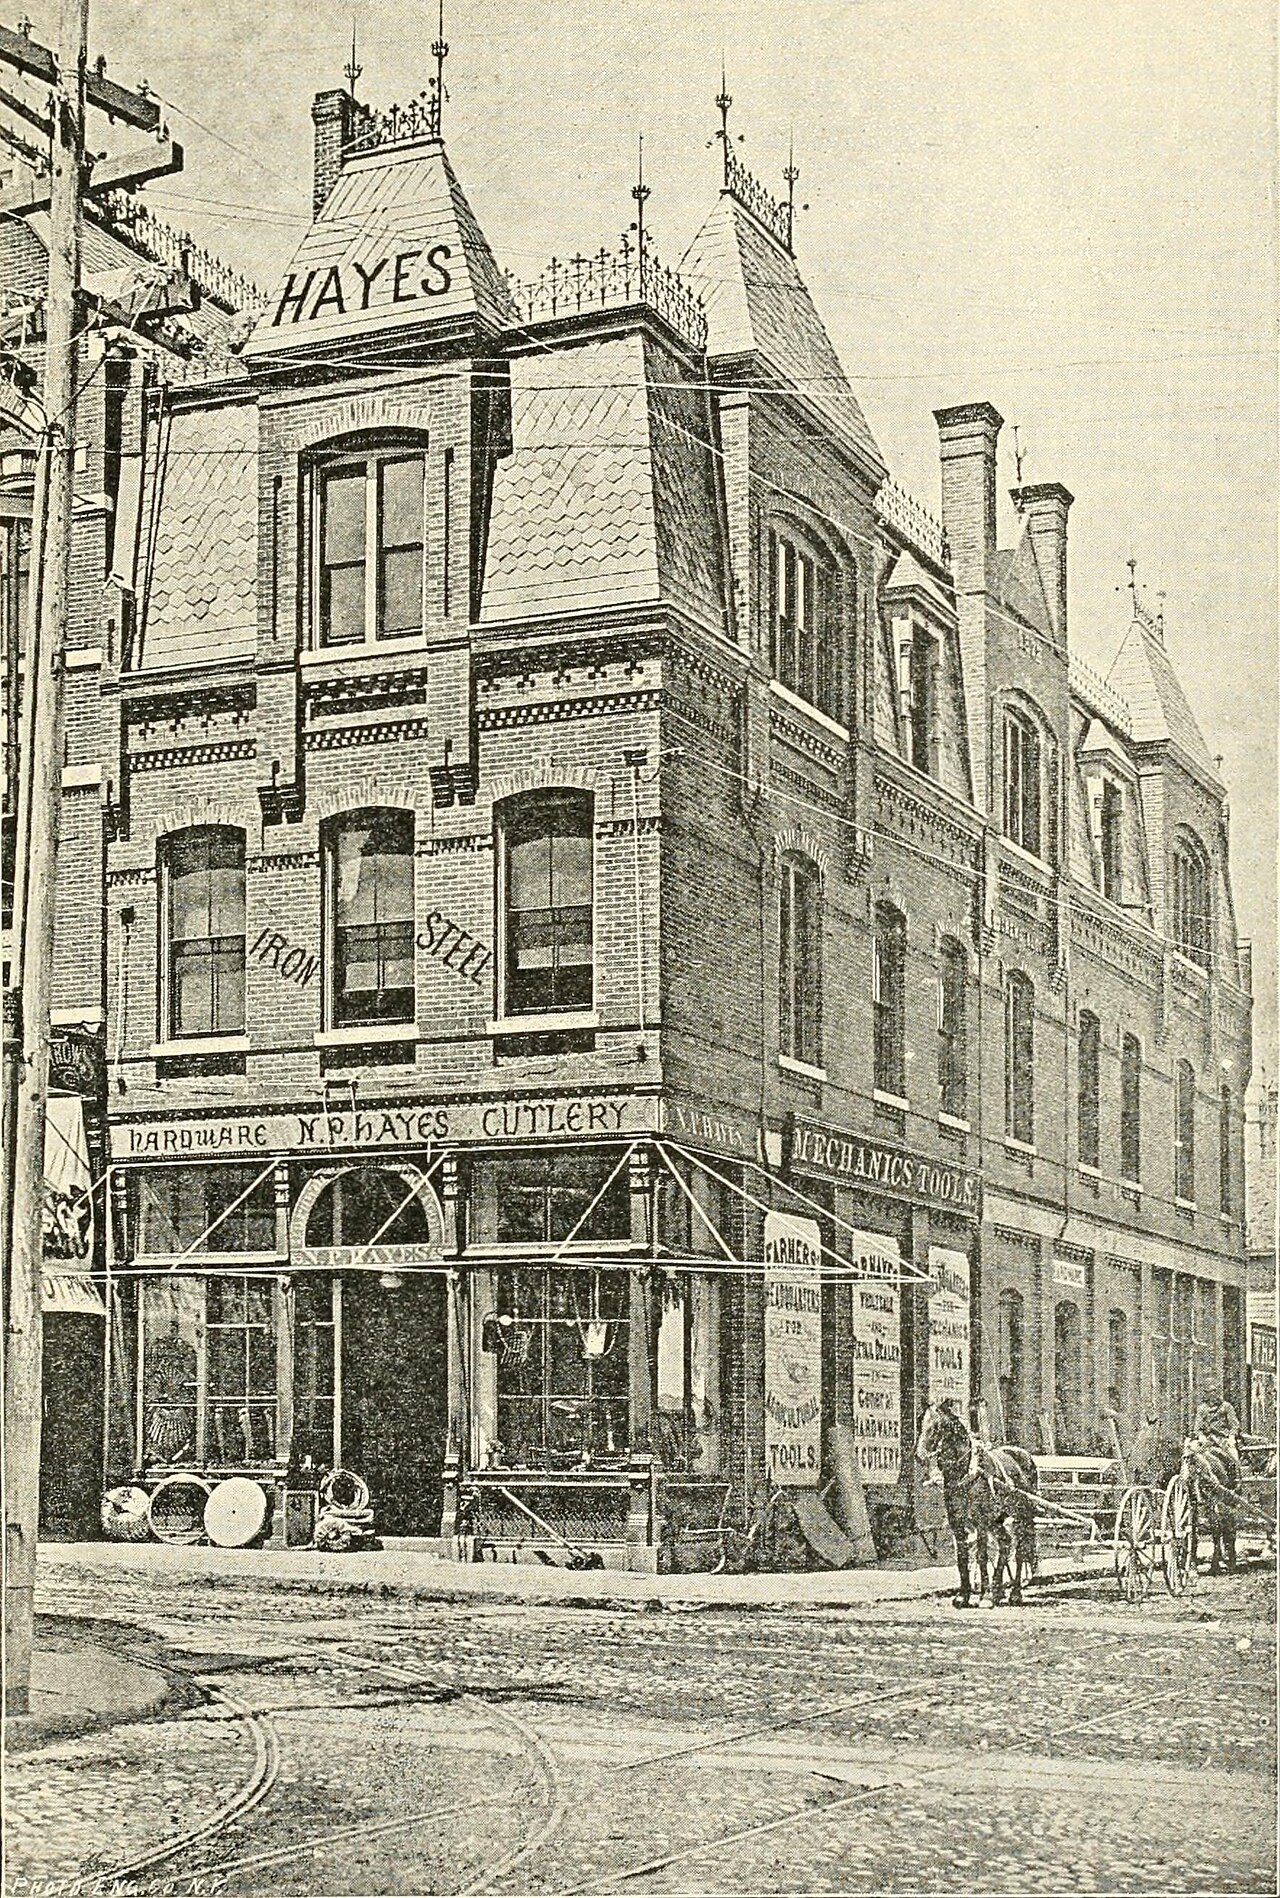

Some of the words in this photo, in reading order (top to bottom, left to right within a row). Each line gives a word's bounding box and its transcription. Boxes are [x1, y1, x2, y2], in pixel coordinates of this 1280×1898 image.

[271, 244, 451, 327] HAYES
[249, 927, 321, 988] IRON
[415, 910, 493, 986] STEEL
[128, 1123, 268, 1152] HARDWARE
[481, 1101, 629, 1137] CUTLERY
[791, 1126, 915, 1189] MECHANICS
